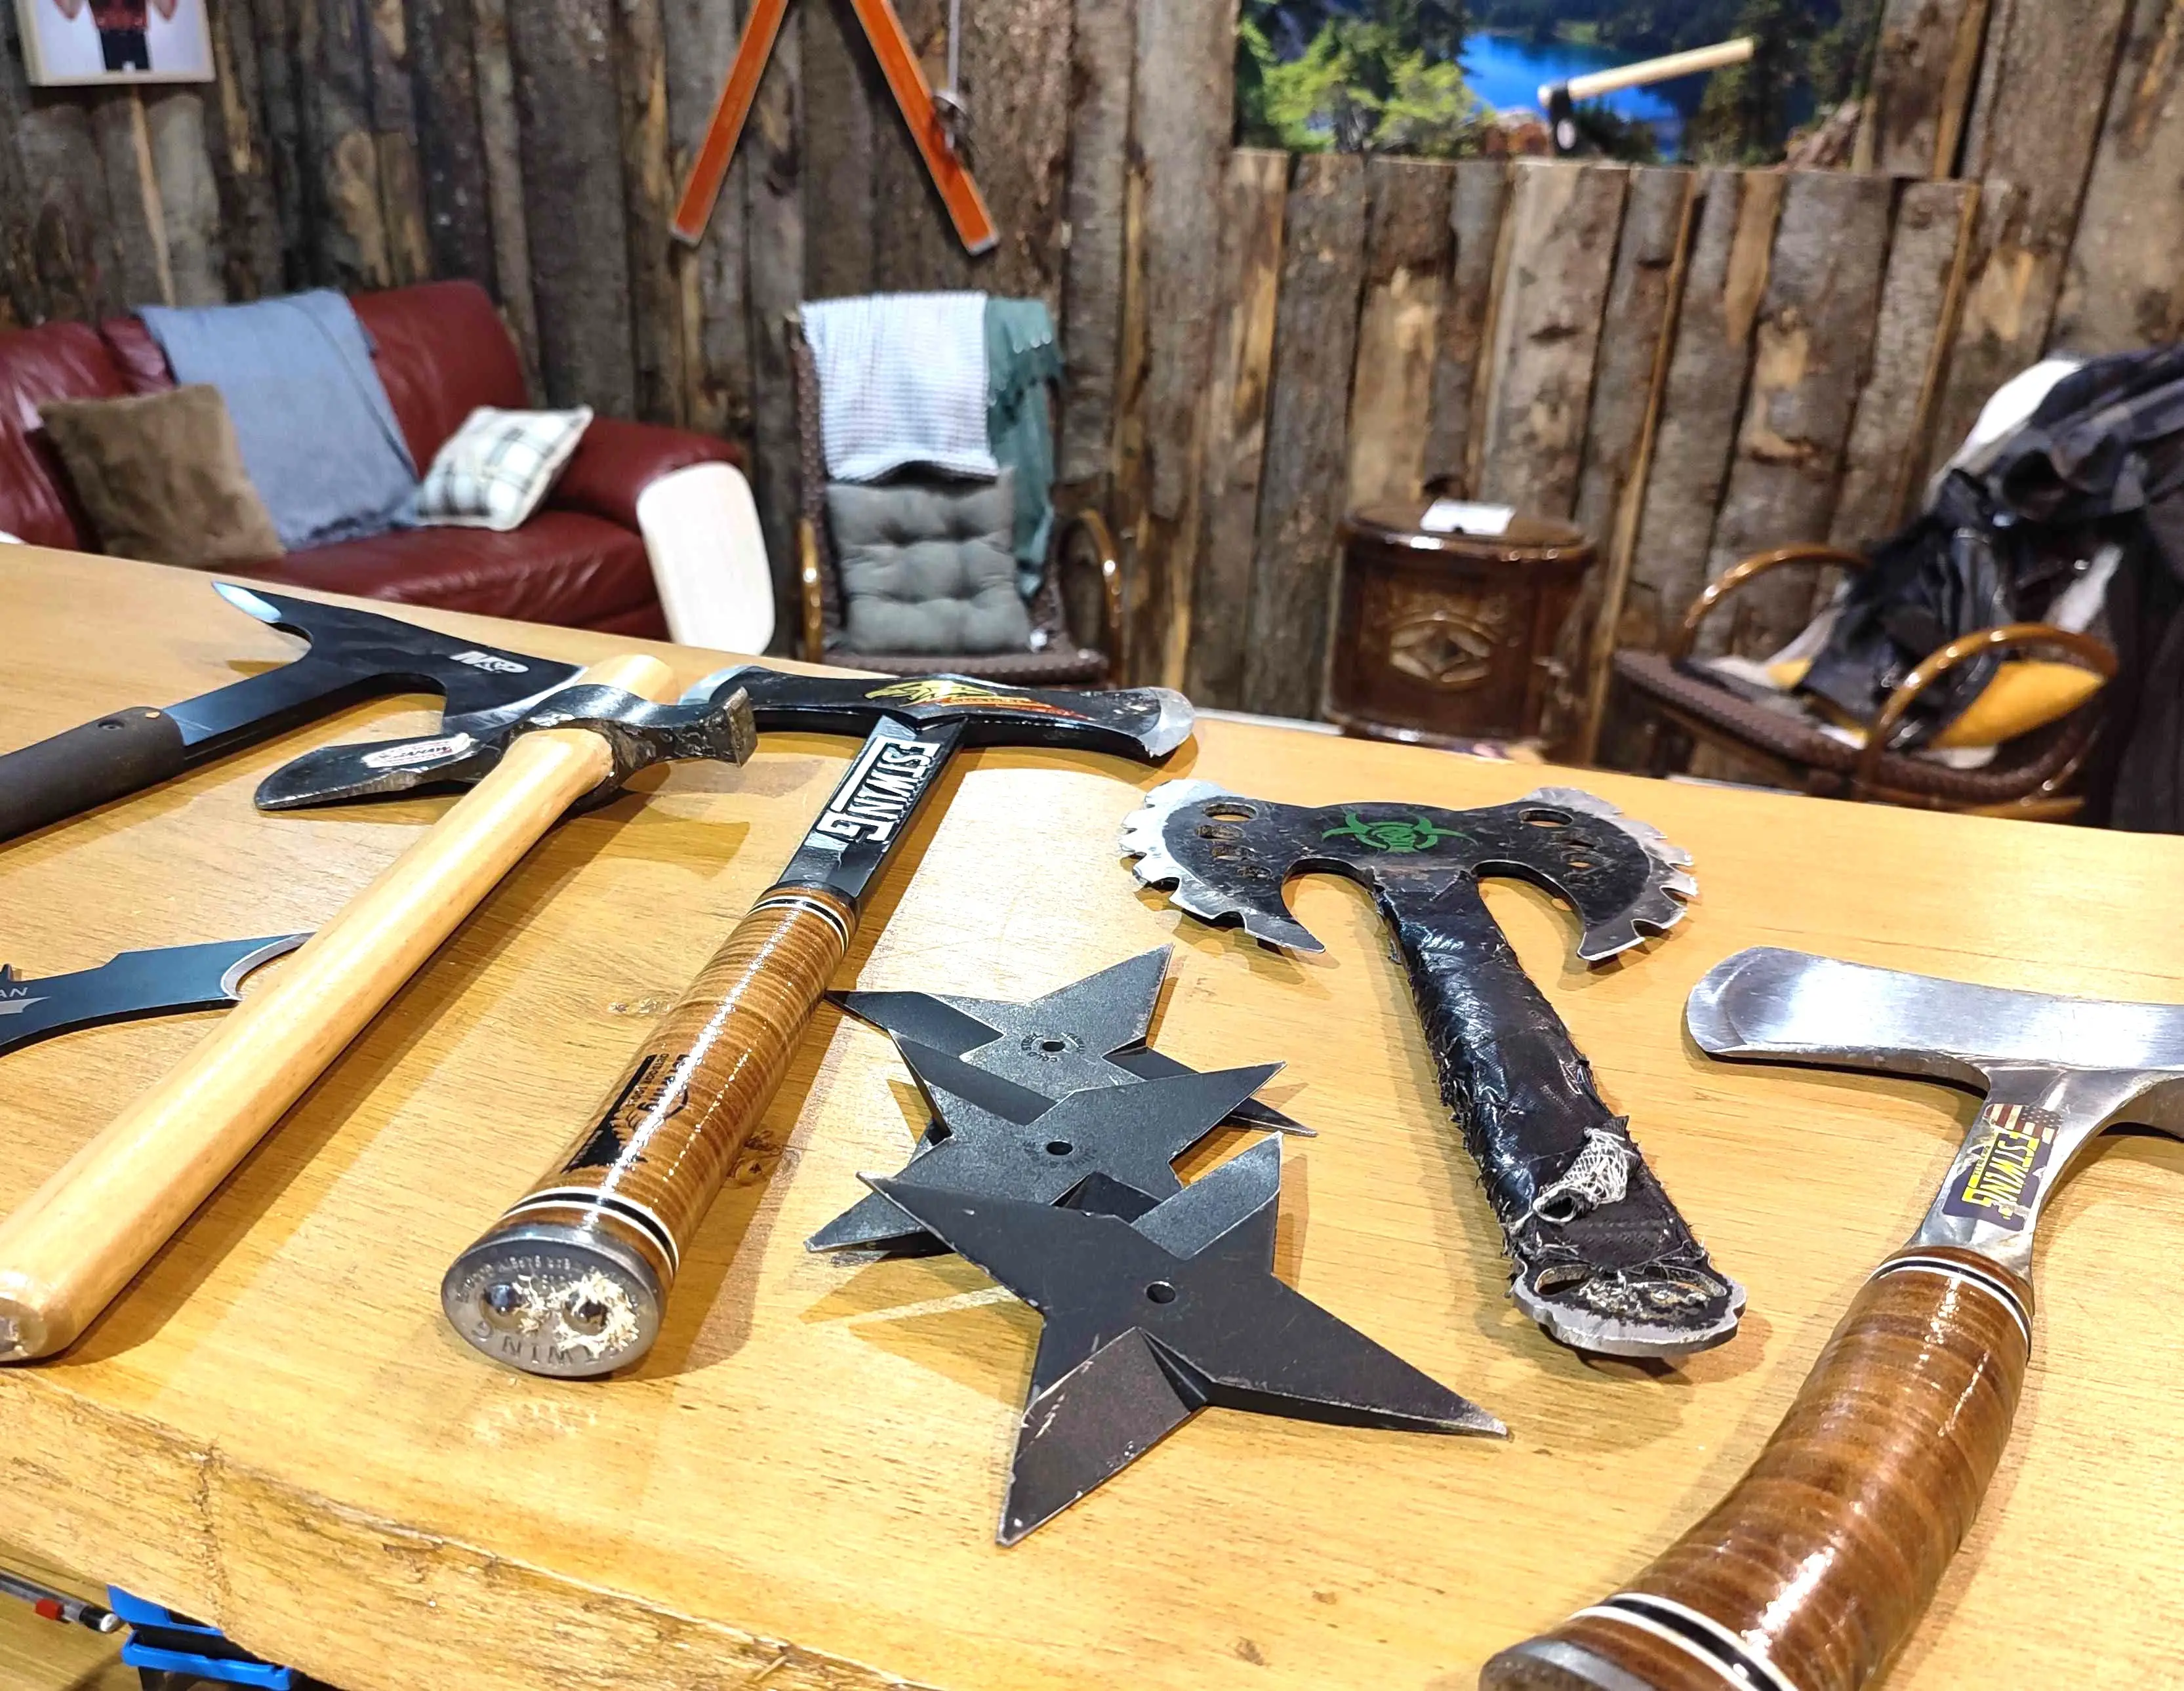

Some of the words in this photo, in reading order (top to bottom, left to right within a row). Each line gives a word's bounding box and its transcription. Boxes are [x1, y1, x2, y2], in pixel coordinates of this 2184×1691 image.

[815, 735, 941, 842] ESTWING
[1027, 1051, 1059, 1063] COLD
[1961, 1128, 2040, 1219] ESTWING
